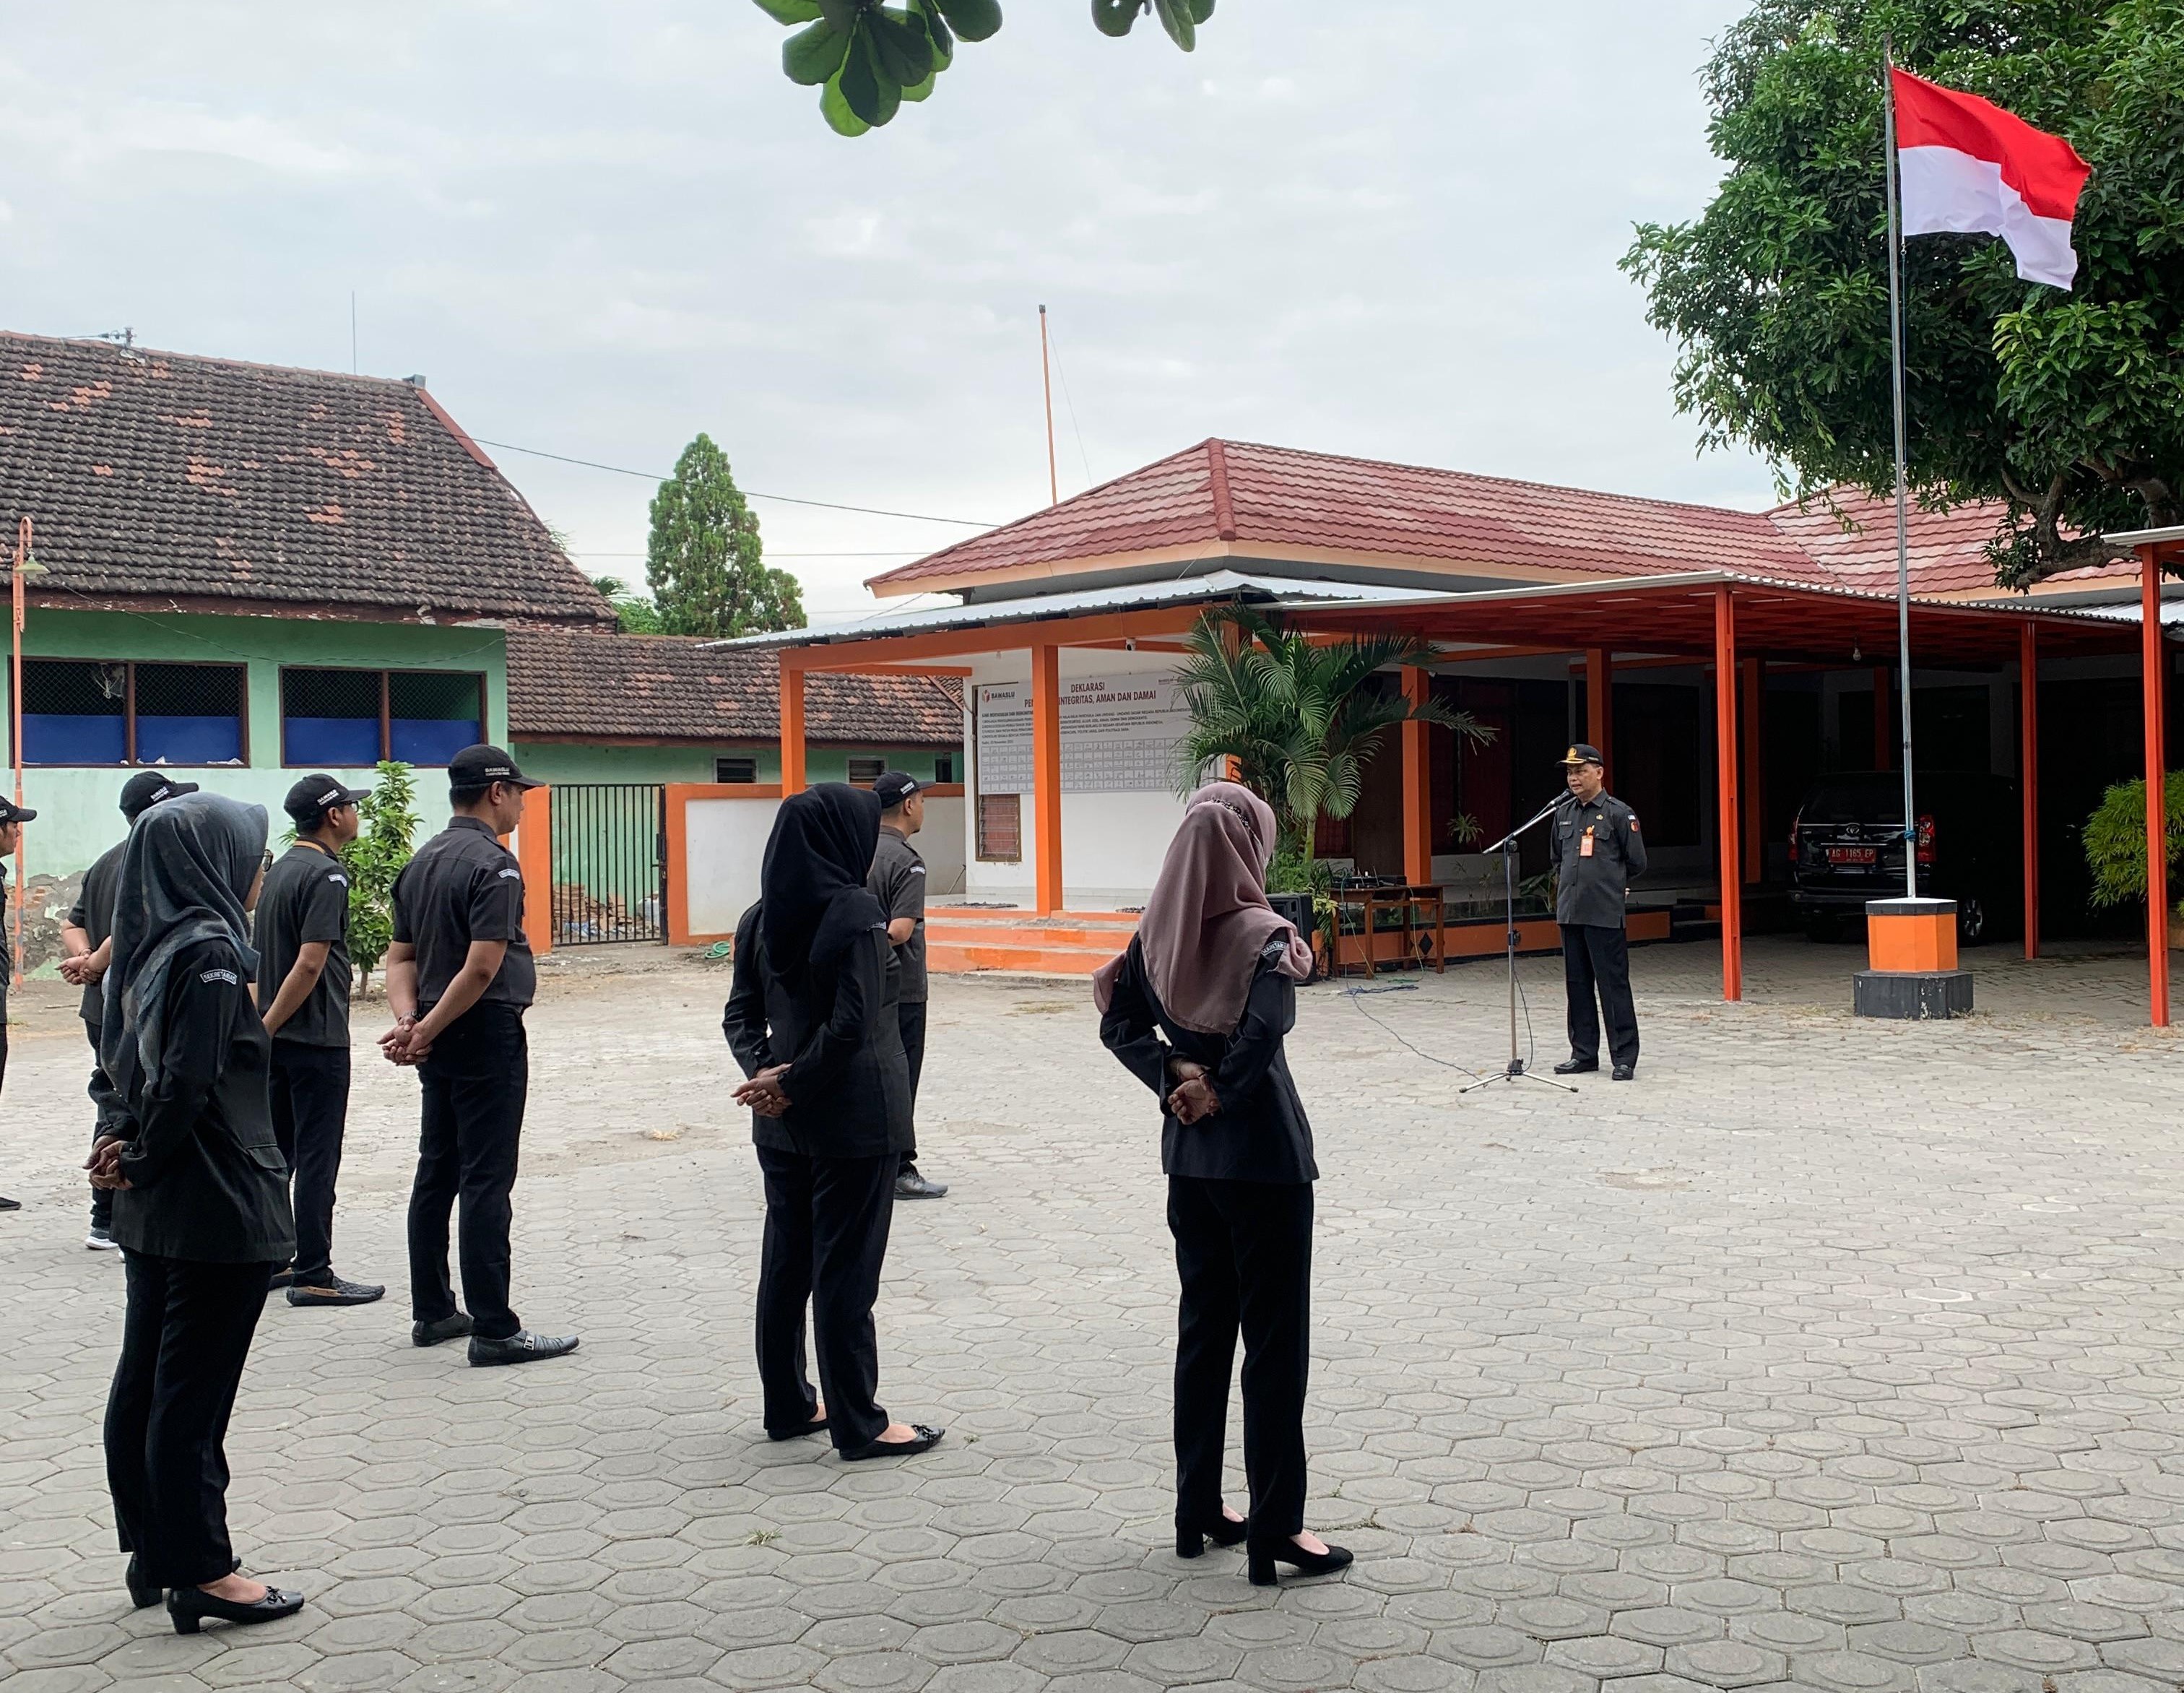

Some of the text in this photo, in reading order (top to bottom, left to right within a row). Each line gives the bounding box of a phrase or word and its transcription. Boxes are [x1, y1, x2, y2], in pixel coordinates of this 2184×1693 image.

[1070, 682, 1105, 693] DEKLARASI
[1096, 693, 1116, 703] AMAN
[1117, 691, 1132, 702] DAN
[1133, 690, 1156, 701] DAMAI
[1832, 848, 1874, 858] AG 1165 EP
